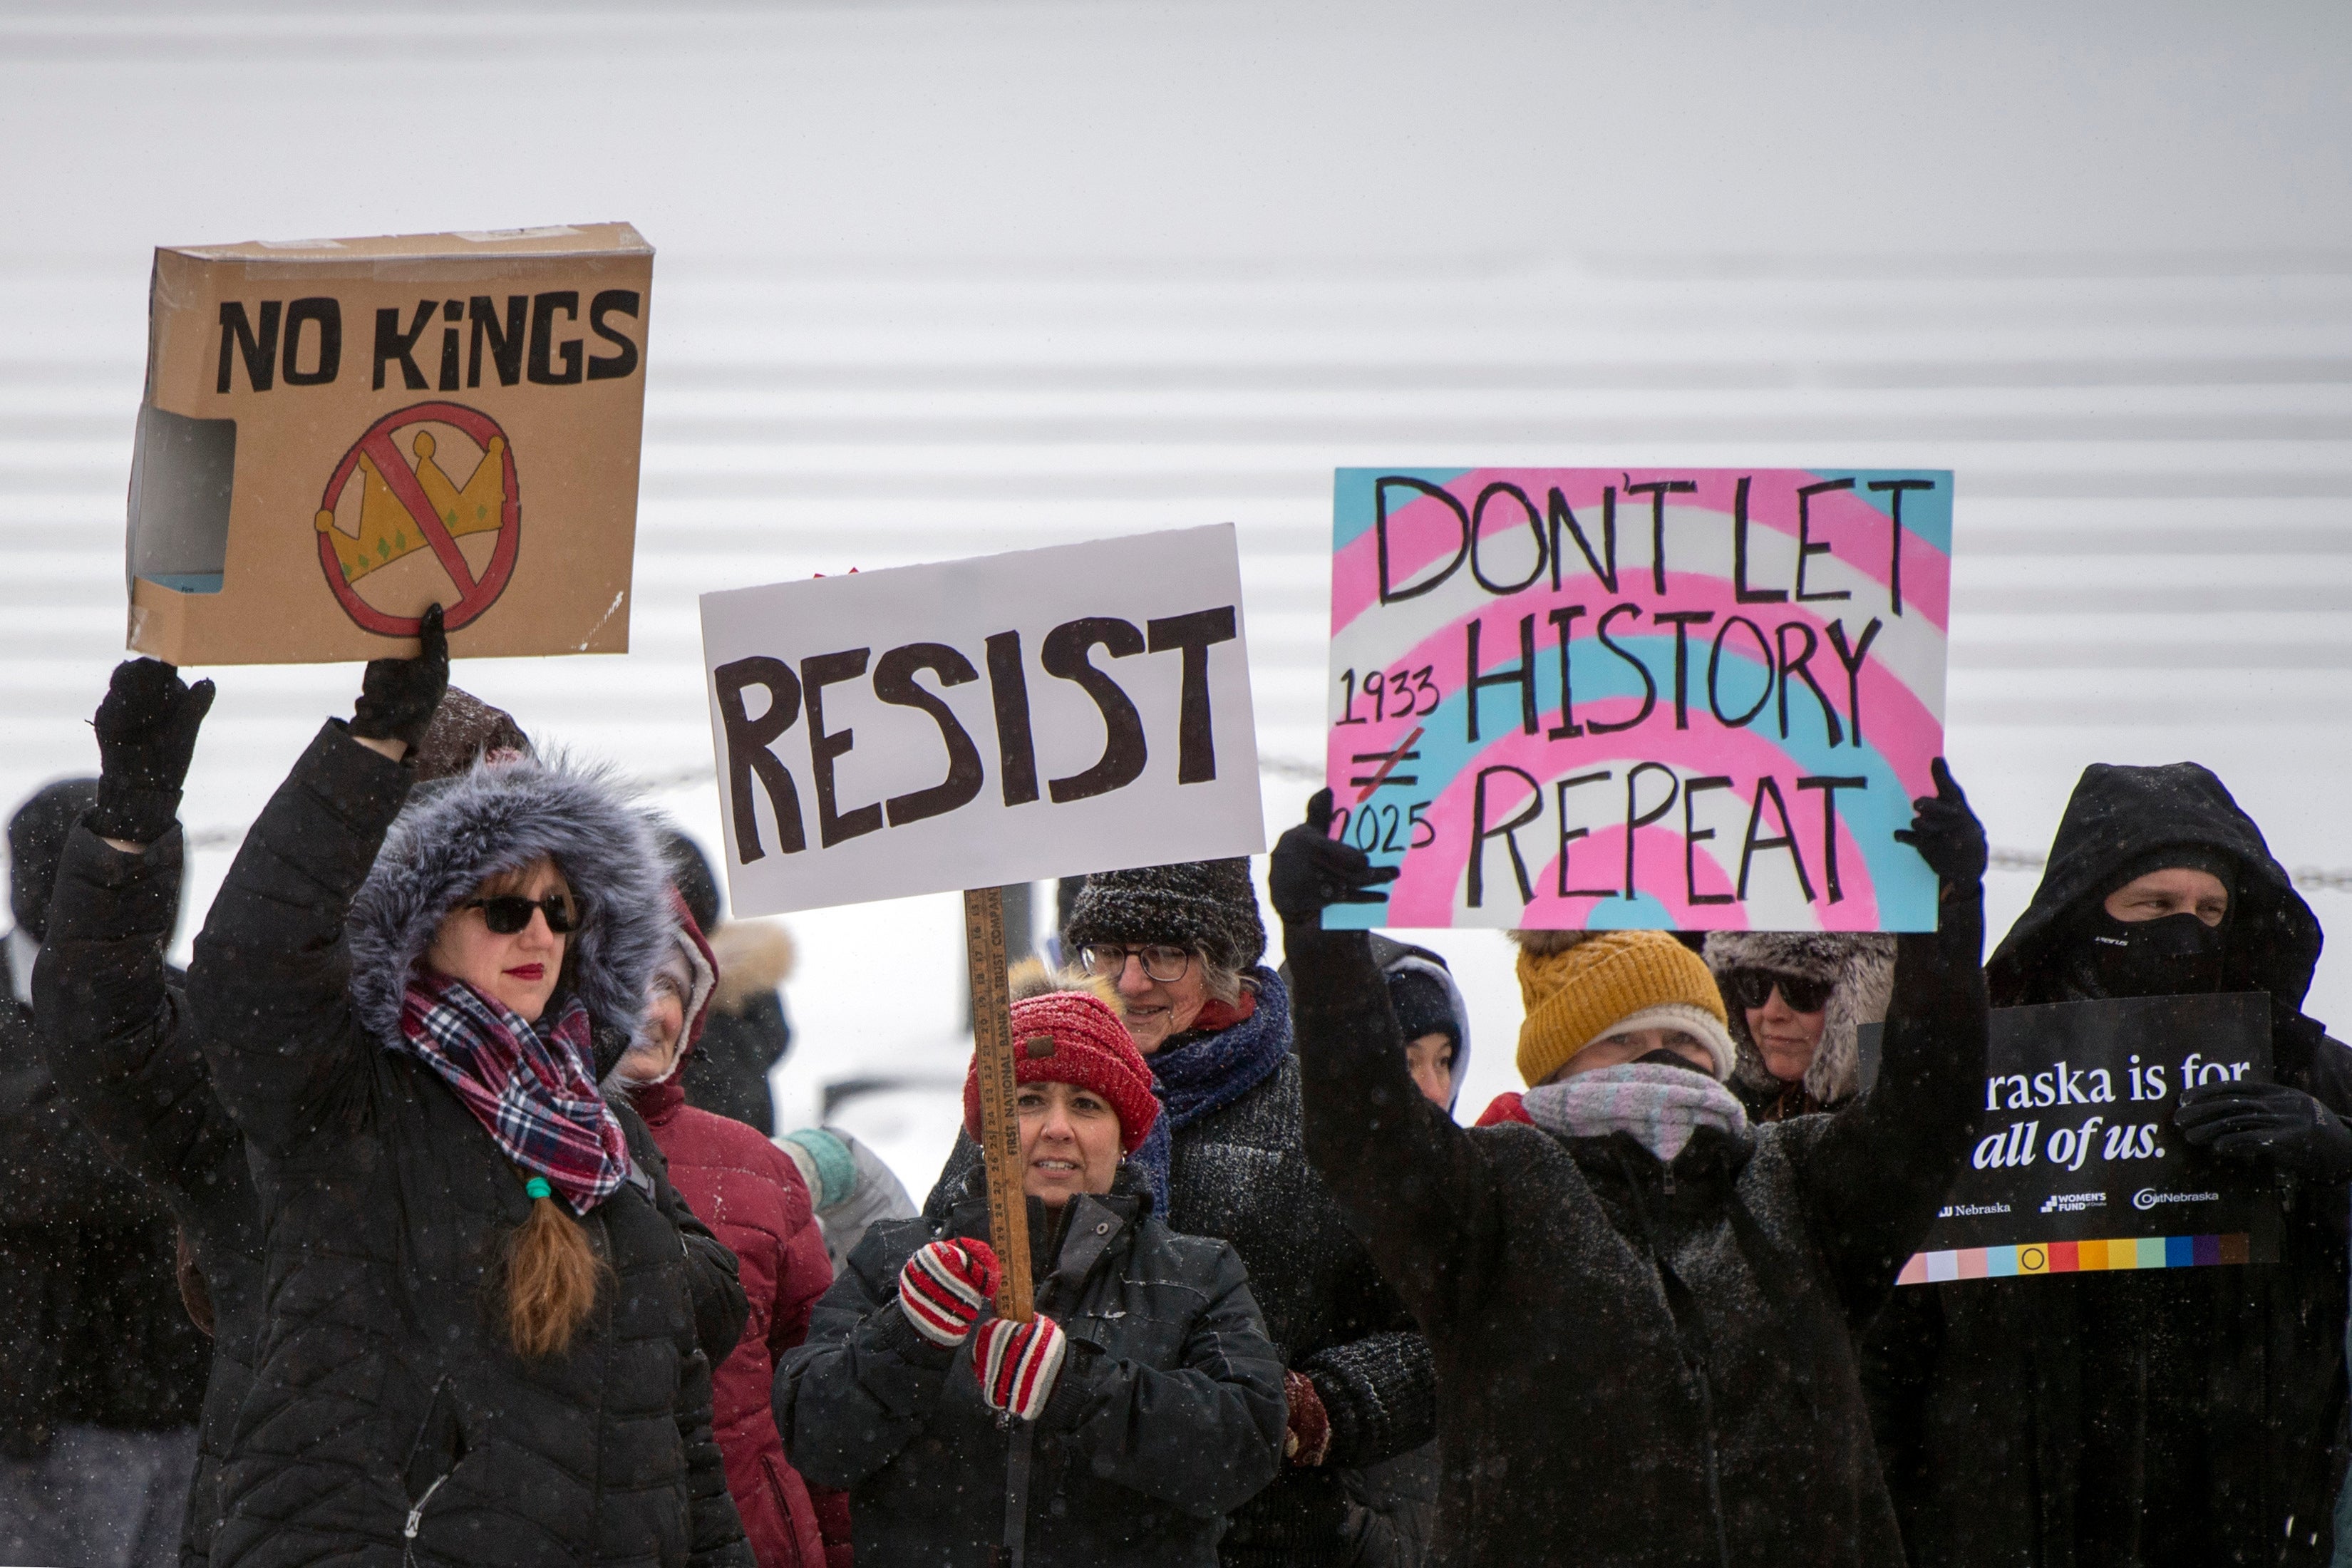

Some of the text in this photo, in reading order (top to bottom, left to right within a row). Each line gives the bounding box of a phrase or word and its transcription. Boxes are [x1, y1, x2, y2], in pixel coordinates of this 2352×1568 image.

[216, 297, 341, 393] NO
[1376, 473, 1936, 617] DON'T LET
[1466, 603, 1883, 748] HISTORY
[1336, 664, 1440, 726] 1933
[714, 605, 1237, 865] RESIST
[1330, 800, 1436, 854] 2025
[1466, 762, 1868, 908] REPEAT
[989, 891, 1002, 947] COMPAN
[975, 951, 984, 962] 17
[993, 953, 1004, 989] TRUST
[980, 1019, 989, 1034] 20
[998, 1011, 1009, 1046] BANK
[984, 1066, 992, 1080] 22
[1000, 1054, 1015, 1118] NATIONAL
[1985, 1053, 2251, 1111] raska is for
[987, 1112, 995, 1126] 24
[989, 1135, 998, 1150] 25
[1006, 1125, 1018, 1156] FIRST
[1971, 1116, 2166, 1172] all of us.
[991, 1158, 999, 1172] 26
[993, 1180, 1001, 1195] 27
[2058, 1192, 2107, 1203] WOMEN'S
[1955, 1202, 2011, 1217] Nebraska
[2058, 1202, 2086, 1212] FUND
[996, 1226, 1004, 1241] 29
